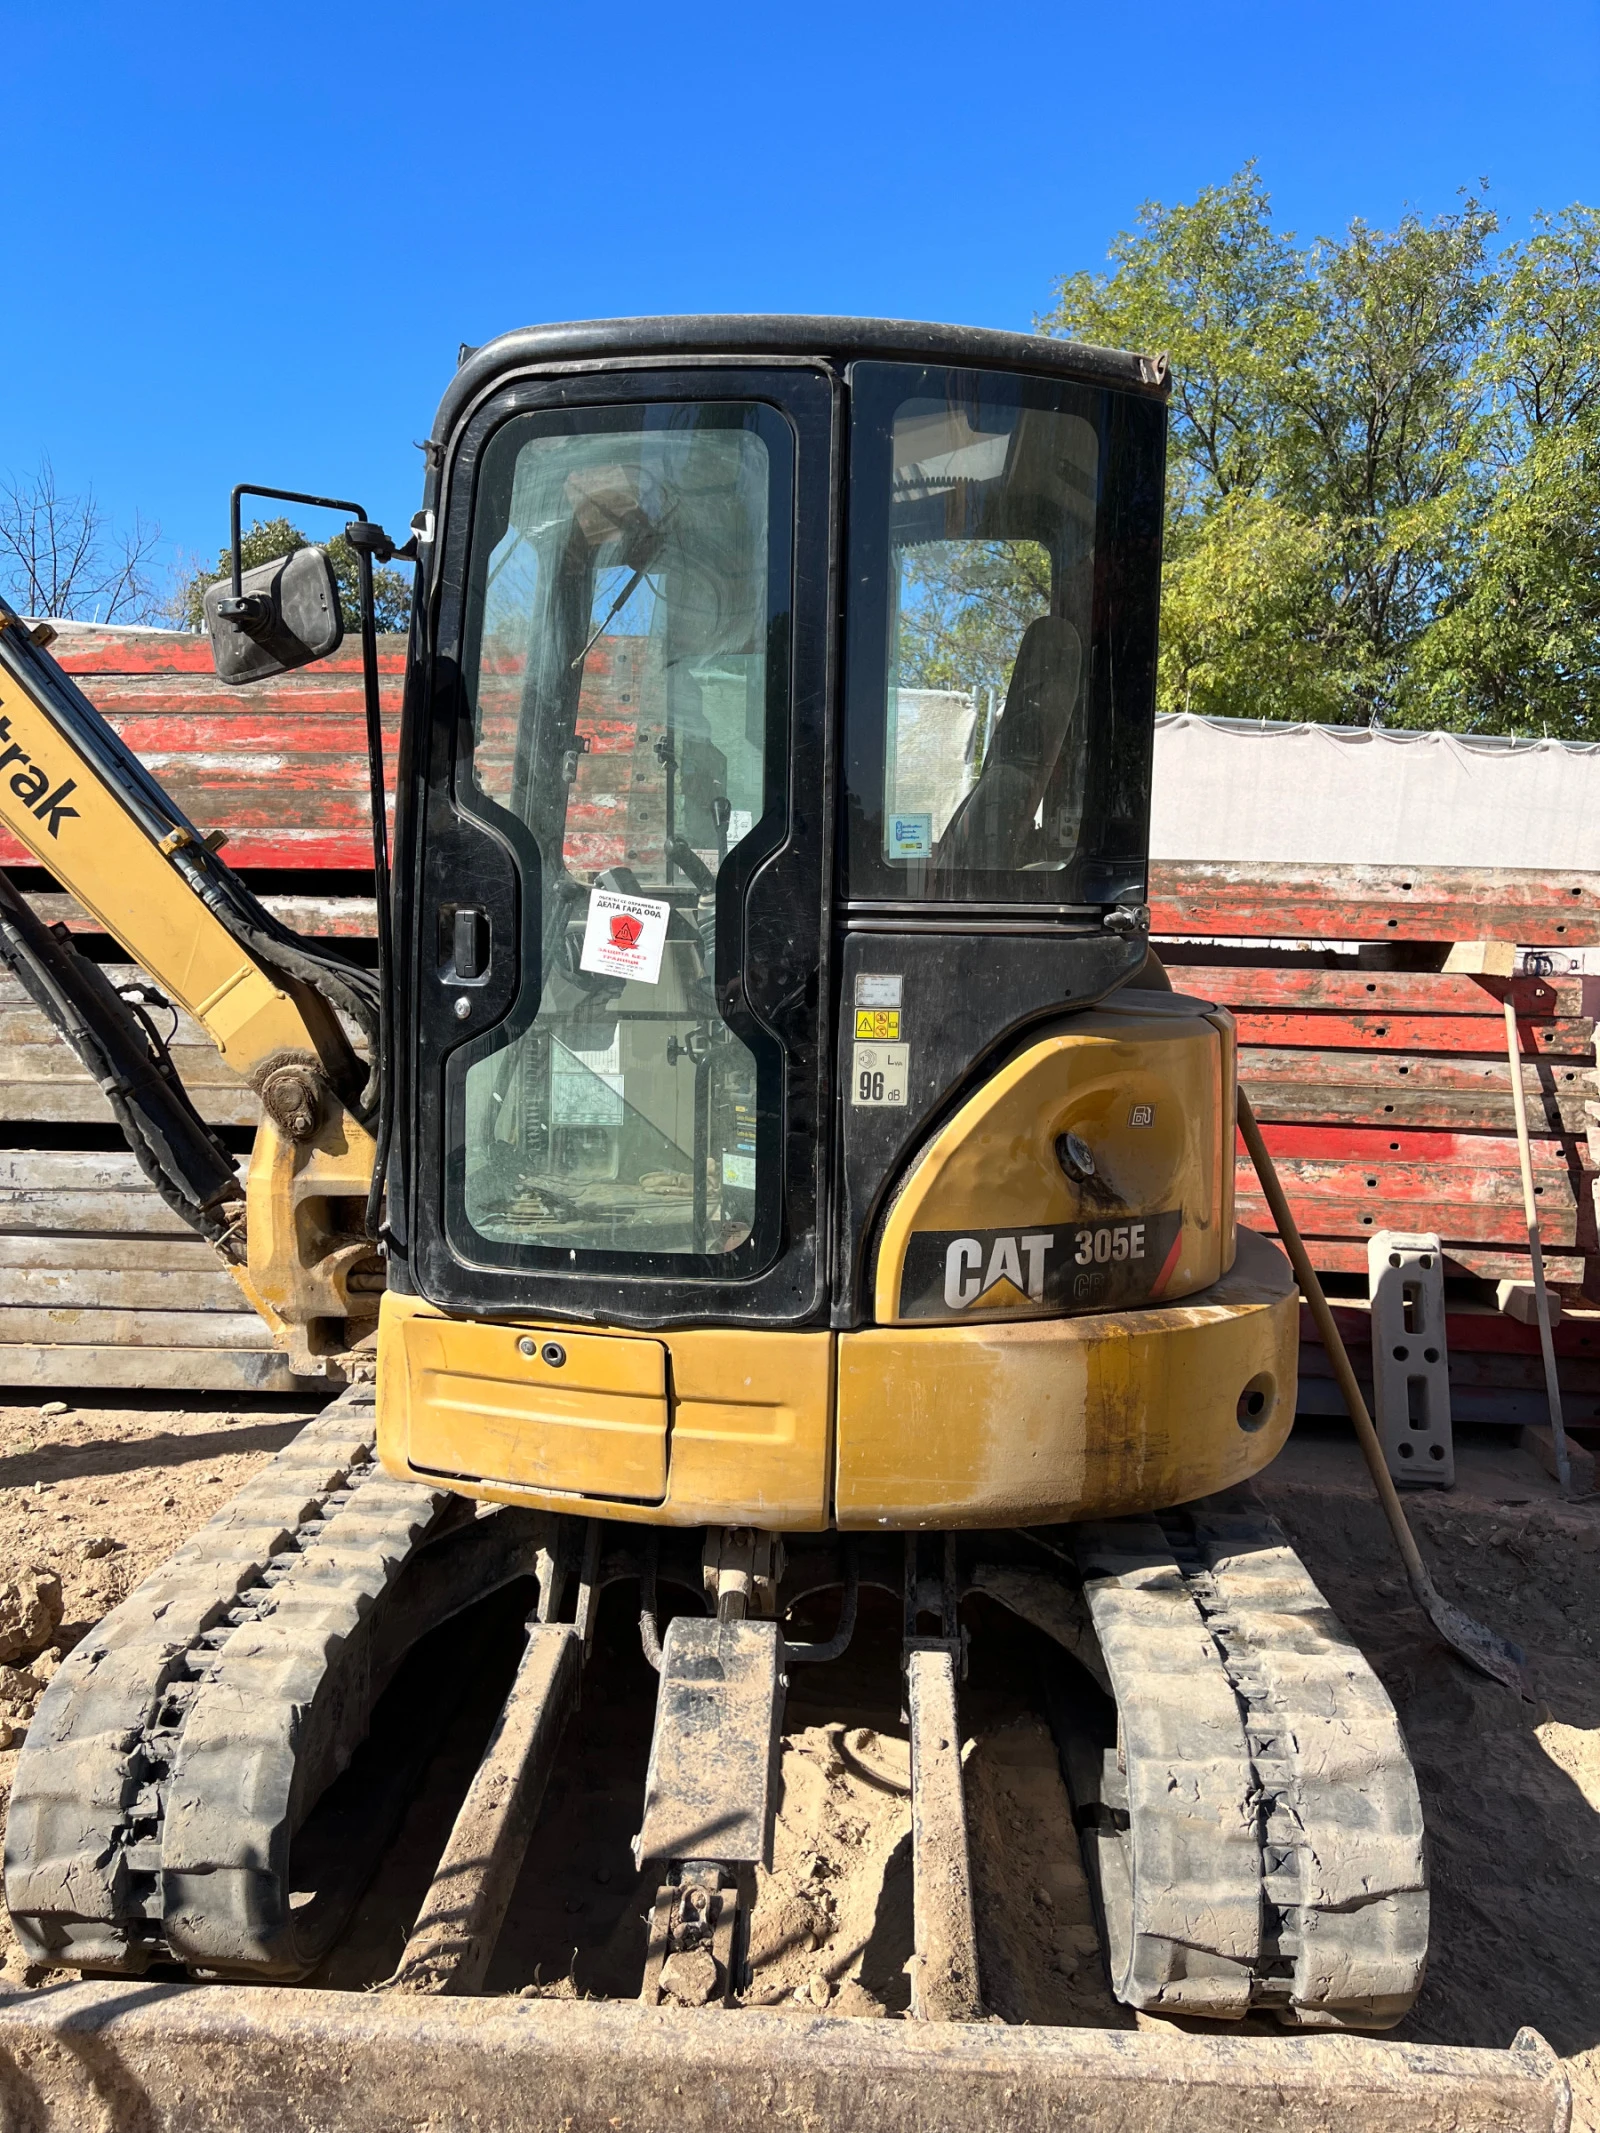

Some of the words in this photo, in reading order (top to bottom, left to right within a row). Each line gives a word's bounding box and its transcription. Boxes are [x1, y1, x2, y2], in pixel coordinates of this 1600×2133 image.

[597, 900, 620, 910] ДЕЛТА
[622, 906, 642, 915] ГАРД
[644, 909, 661, 918] ООД
[860, 1071, 884, 1100] 96
[888, 1089, 900, 1100] dB
[944, 1233, 1054, 1309] CAT
[1074, 1224, 1146, 1266] 305E
